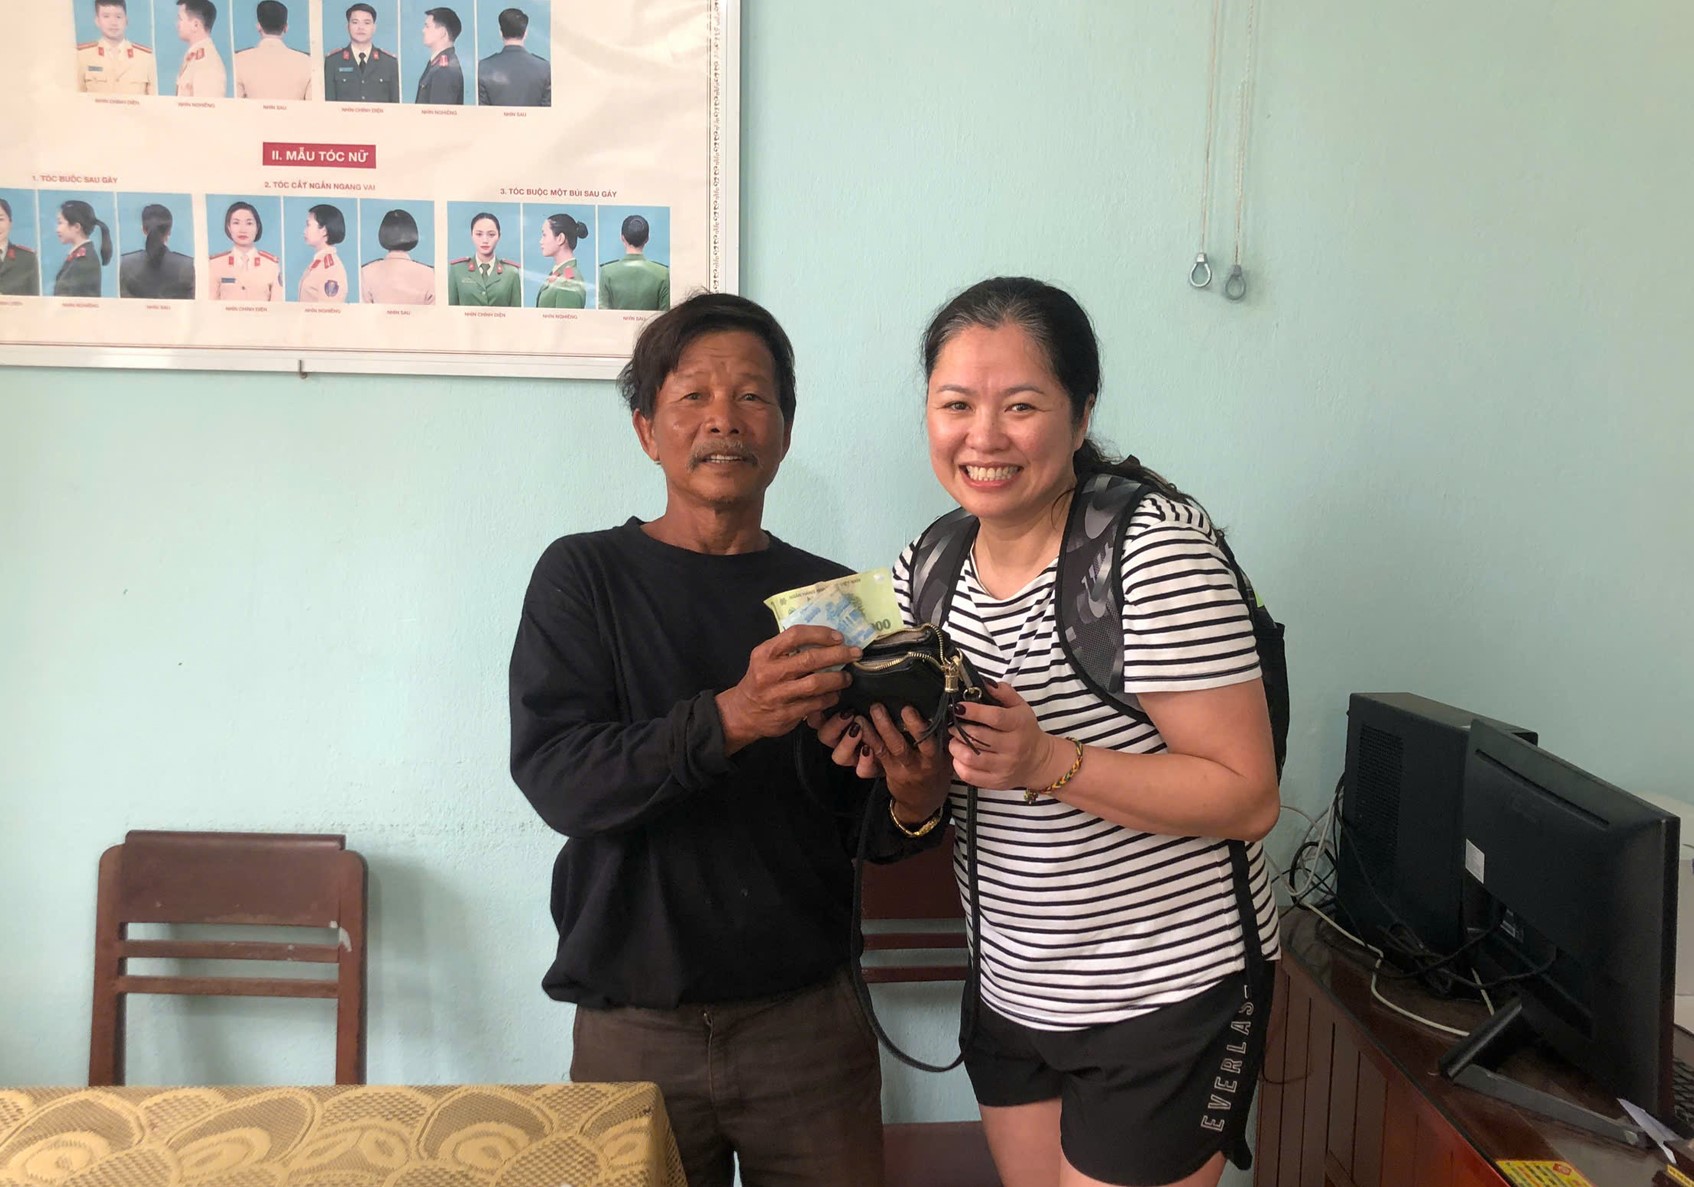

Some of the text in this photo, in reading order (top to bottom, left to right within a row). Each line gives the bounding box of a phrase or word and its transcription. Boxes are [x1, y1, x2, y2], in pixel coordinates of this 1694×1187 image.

[271, 146, 369, 163] II. MẪU TÓC NỮ
[84, 176, 100, 184] SAU
[264, 181, 271, 189] 2.
[273, 180, 290, 189] TÓC
[333, 182, 362, 191] NGANG
[508, 187, 525, 196] TÓC
[526, 188, 548, 197] BUỘC
[550, 188, 568, 197] MỘT
[584, 190, 600, 198] SAU
